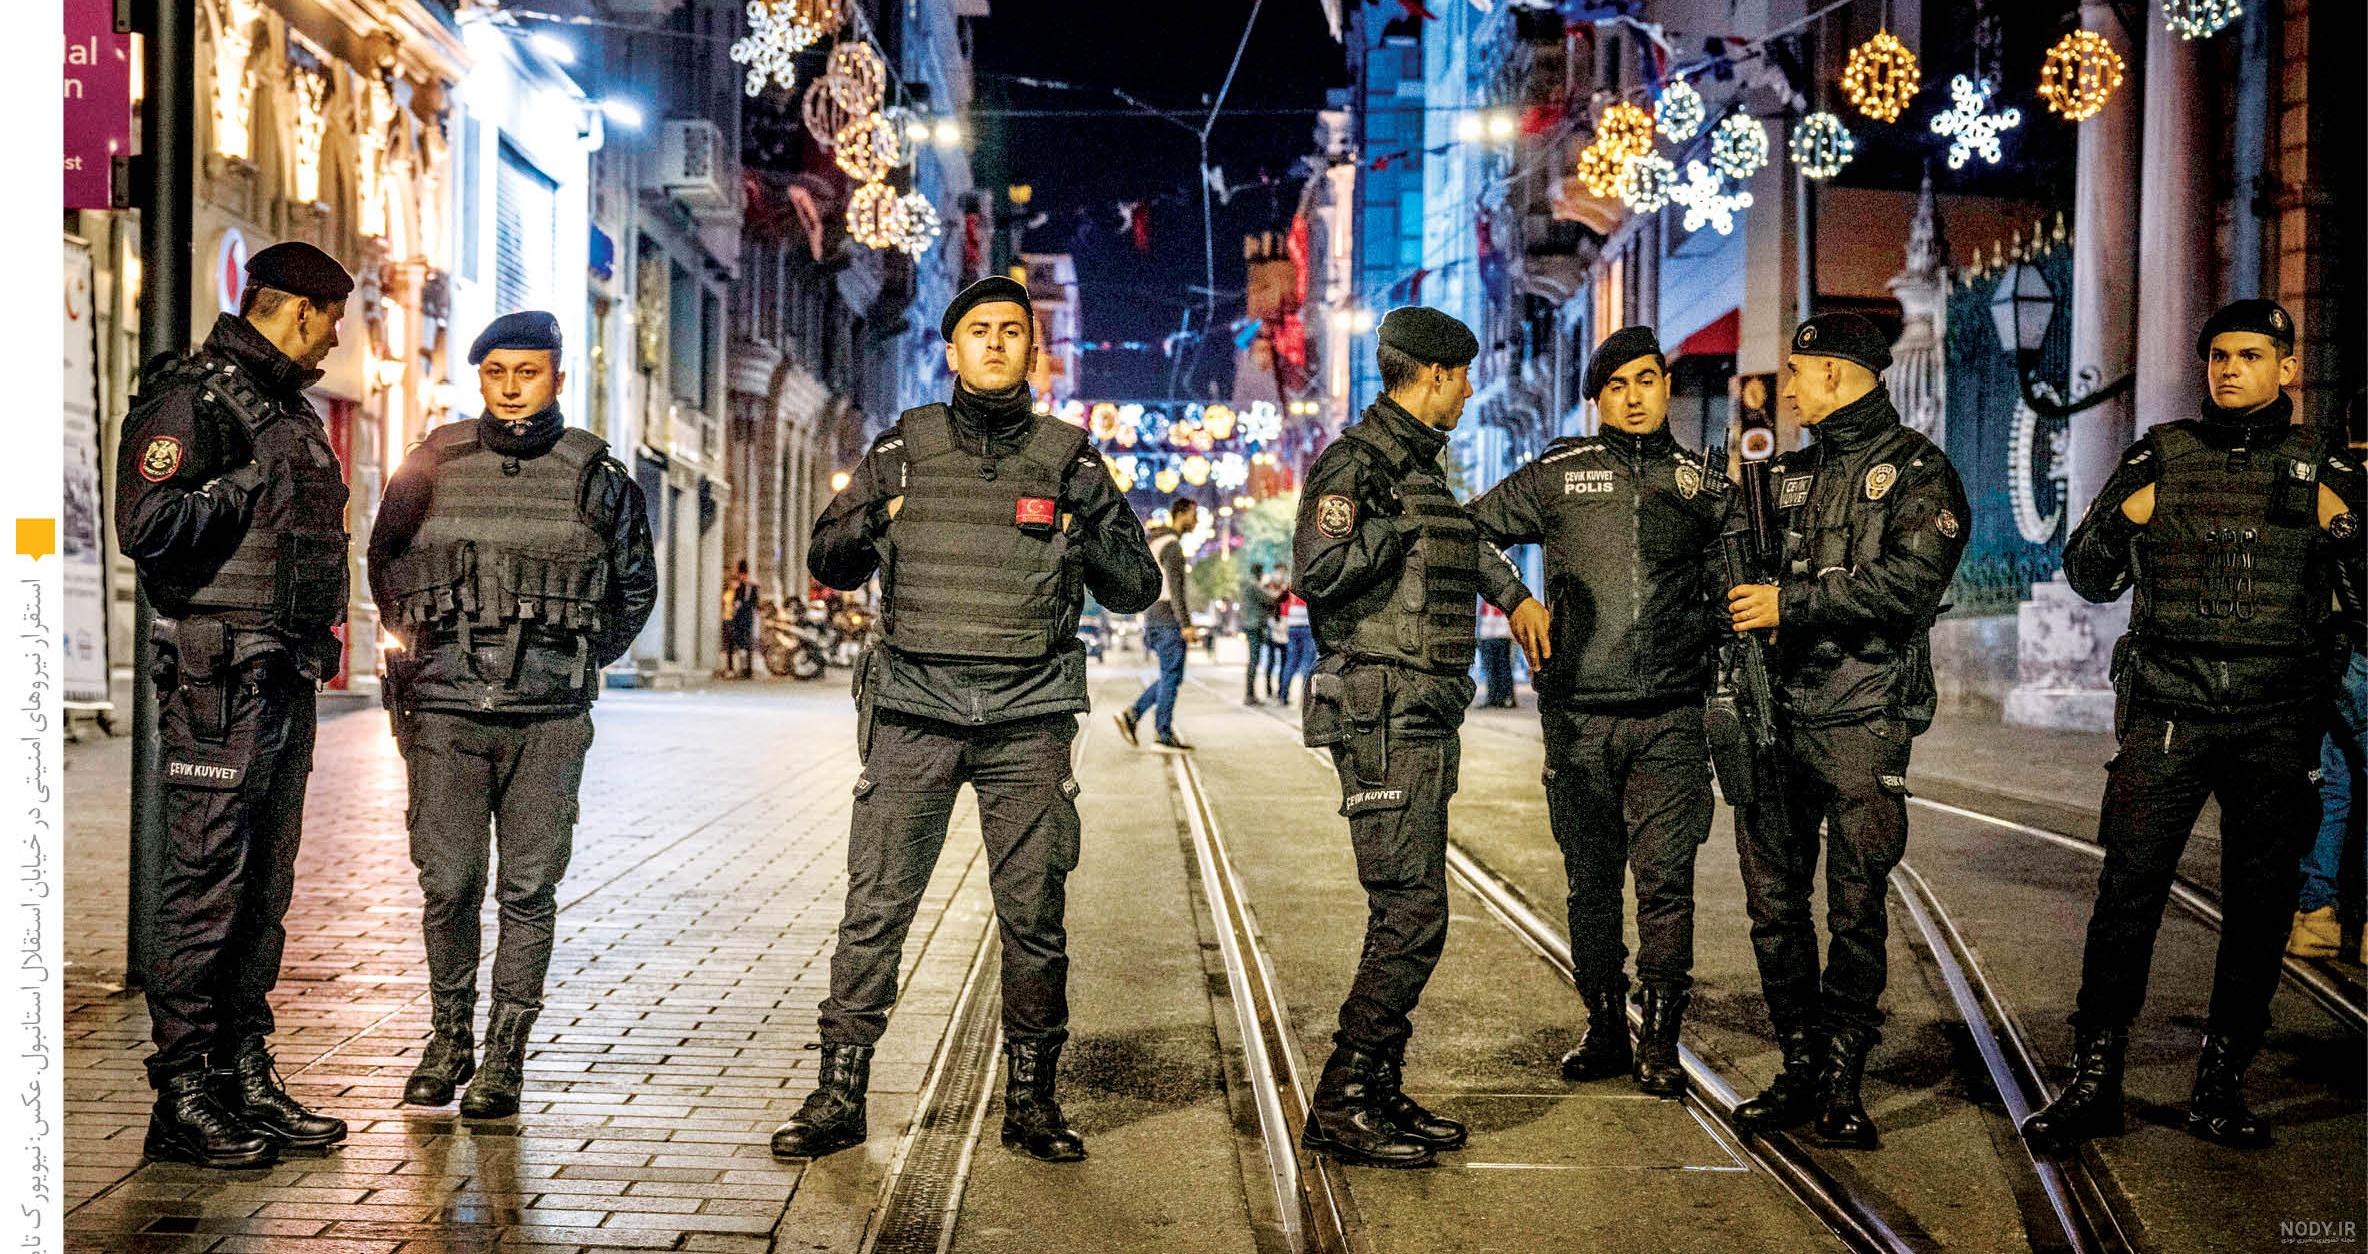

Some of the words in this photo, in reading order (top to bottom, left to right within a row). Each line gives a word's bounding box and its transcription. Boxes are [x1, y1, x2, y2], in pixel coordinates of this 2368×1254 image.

[64, 34, 97, 65] al
[64, 155, 82, 170] st
[194, 765, 237, 780] KUVVET
[1364, 790, 1402, 801] KUVVET
